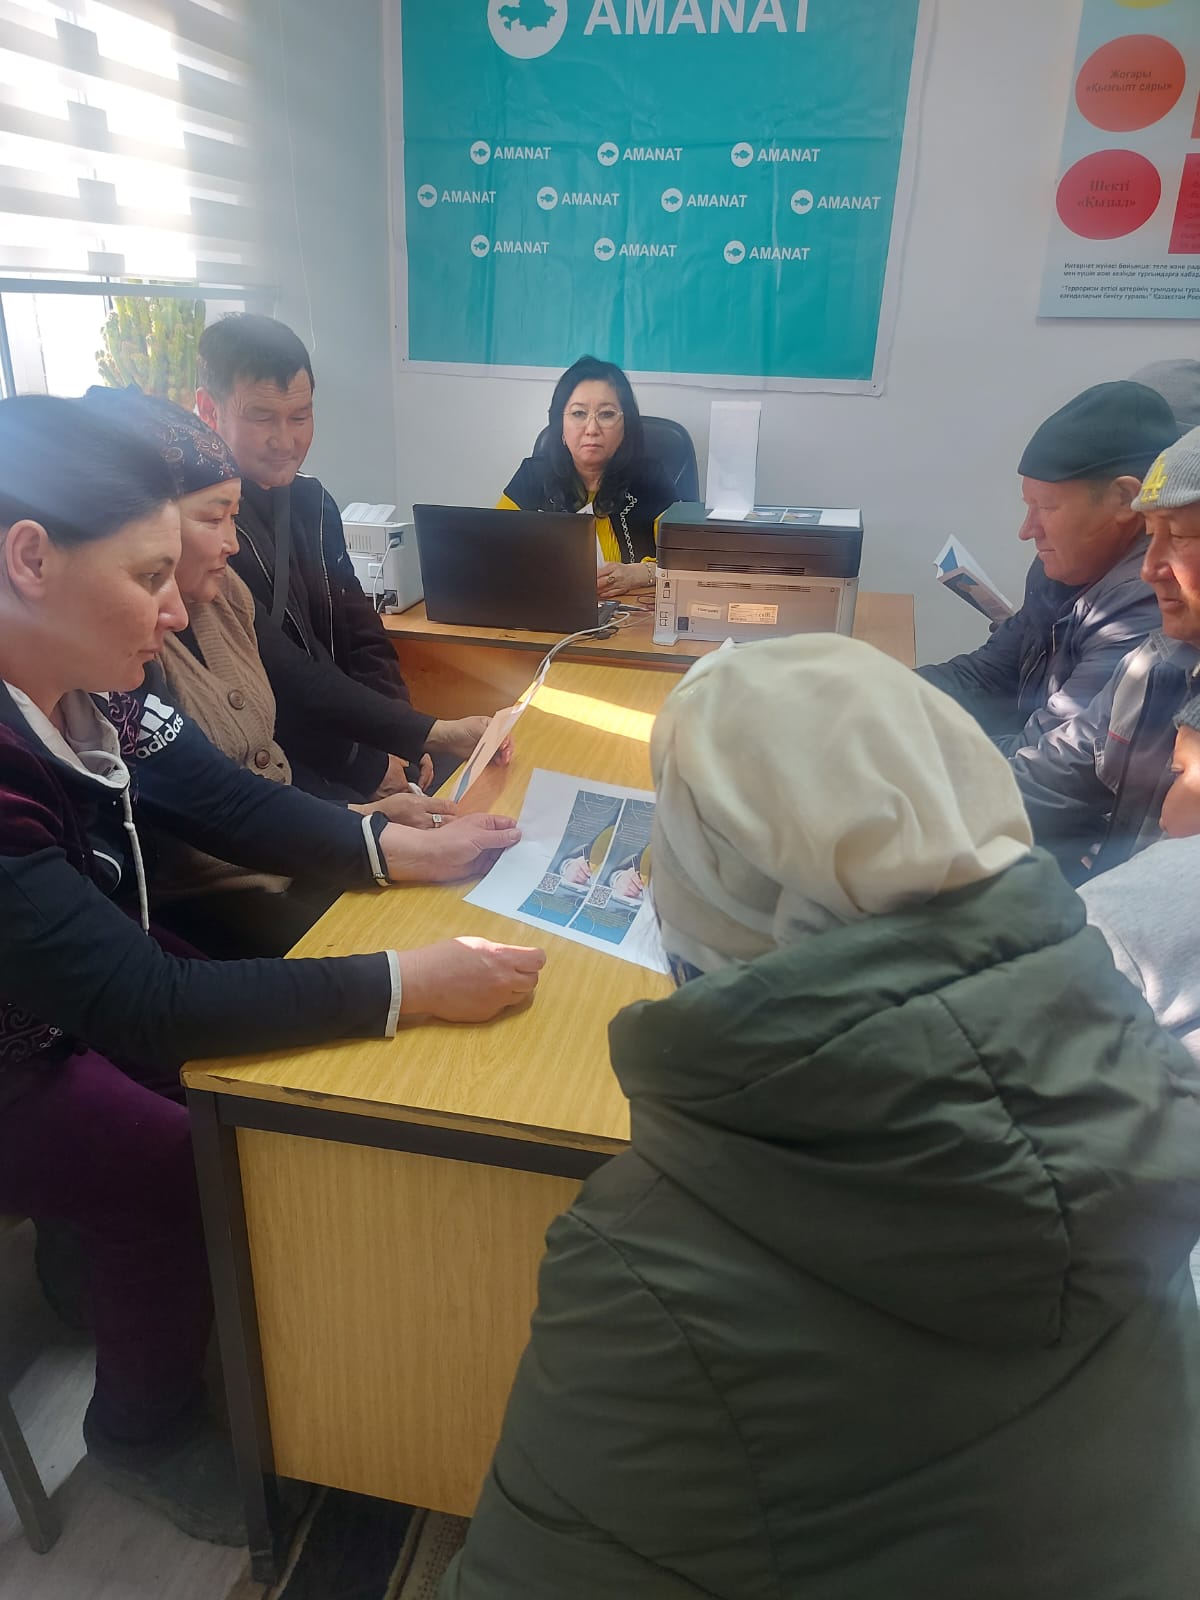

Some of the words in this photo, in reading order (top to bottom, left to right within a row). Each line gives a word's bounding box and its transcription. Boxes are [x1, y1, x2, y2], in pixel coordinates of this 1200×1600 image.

[493, 146, 551, 160] AMANAT
[623, 147, 682, 161] AMANAT
[757, 148, 821, 162] AMANAT
[441, 190, 496, 204] AMANAT
[561, 192, 620, 206] AMANAT
[686, 194, 747, 208] AMANAT
[817, 195, 881, 210] AMANAT
[493, 240, 550, 254] AMANAT
[618, 243, 677, 257] AMANAT
[749, 245, 811, 260] AMANAT
[135, 713, 184, 759] adidas
